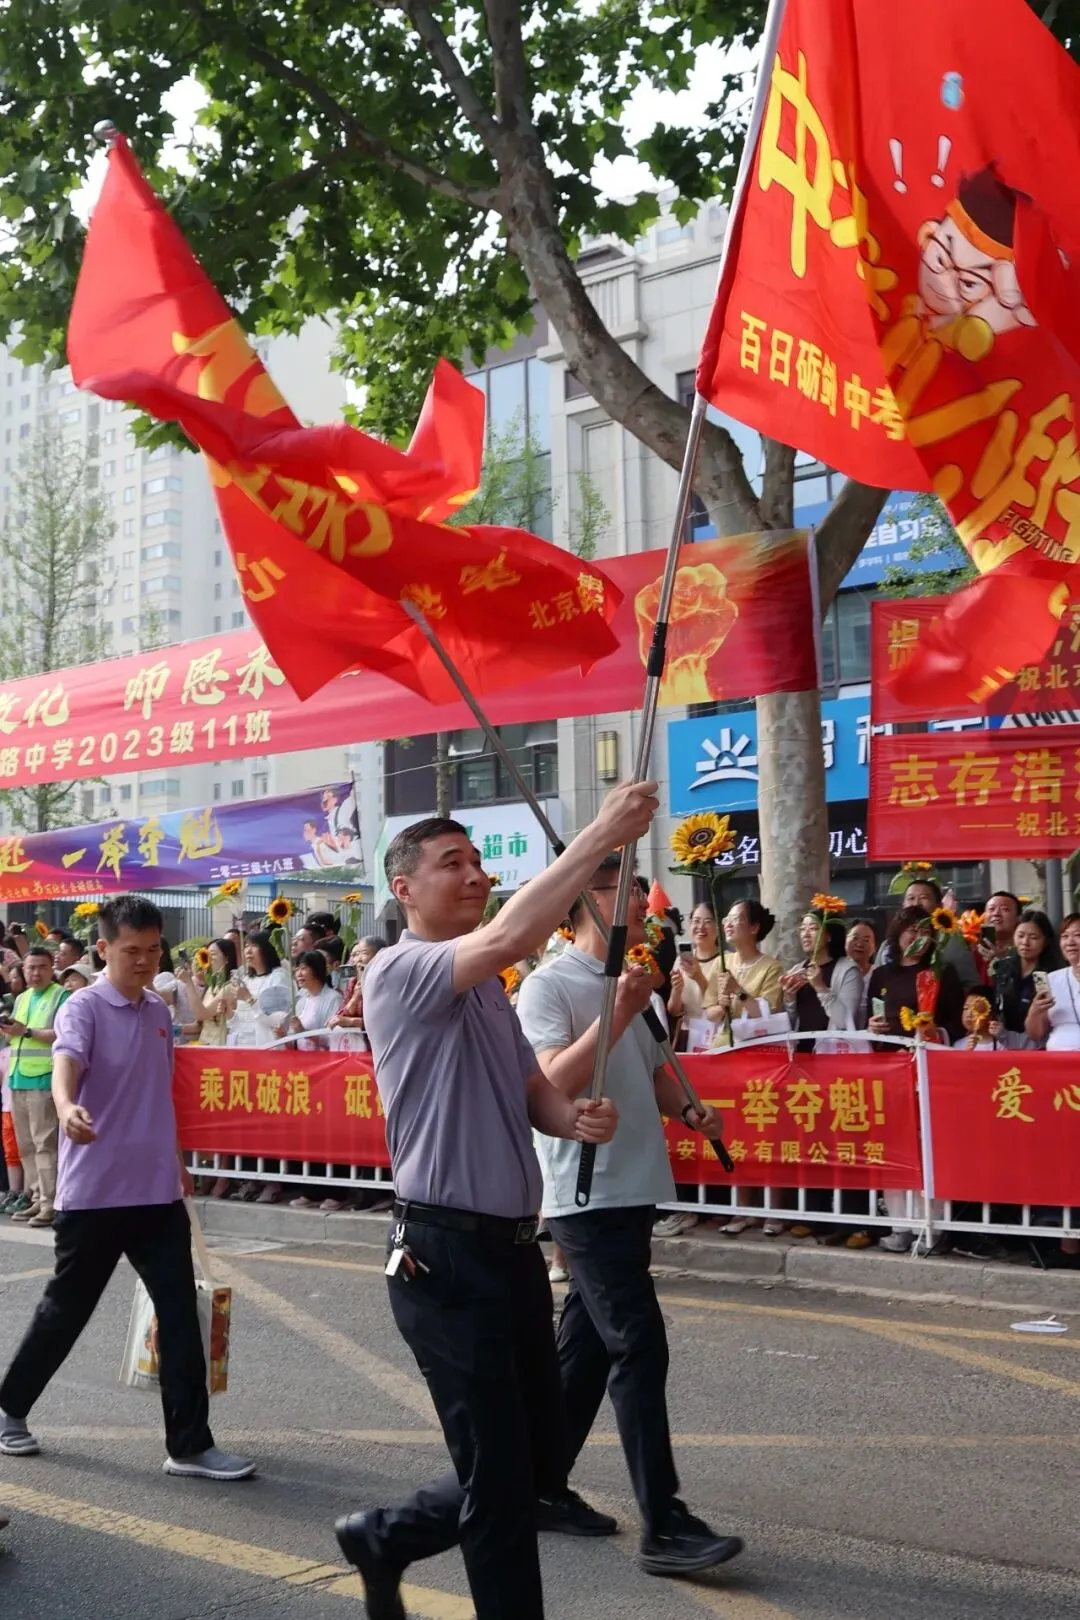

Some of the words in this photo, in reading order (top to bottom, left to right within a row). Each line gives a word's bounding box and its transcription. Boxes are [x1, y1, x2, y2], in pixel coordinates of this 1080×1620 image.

[998, 508, 1076, 564] FIGHTING
[888, 748, 1080, 808] 志存浩
[665, 1139, 886, 1165] 安服务有限公司贺
